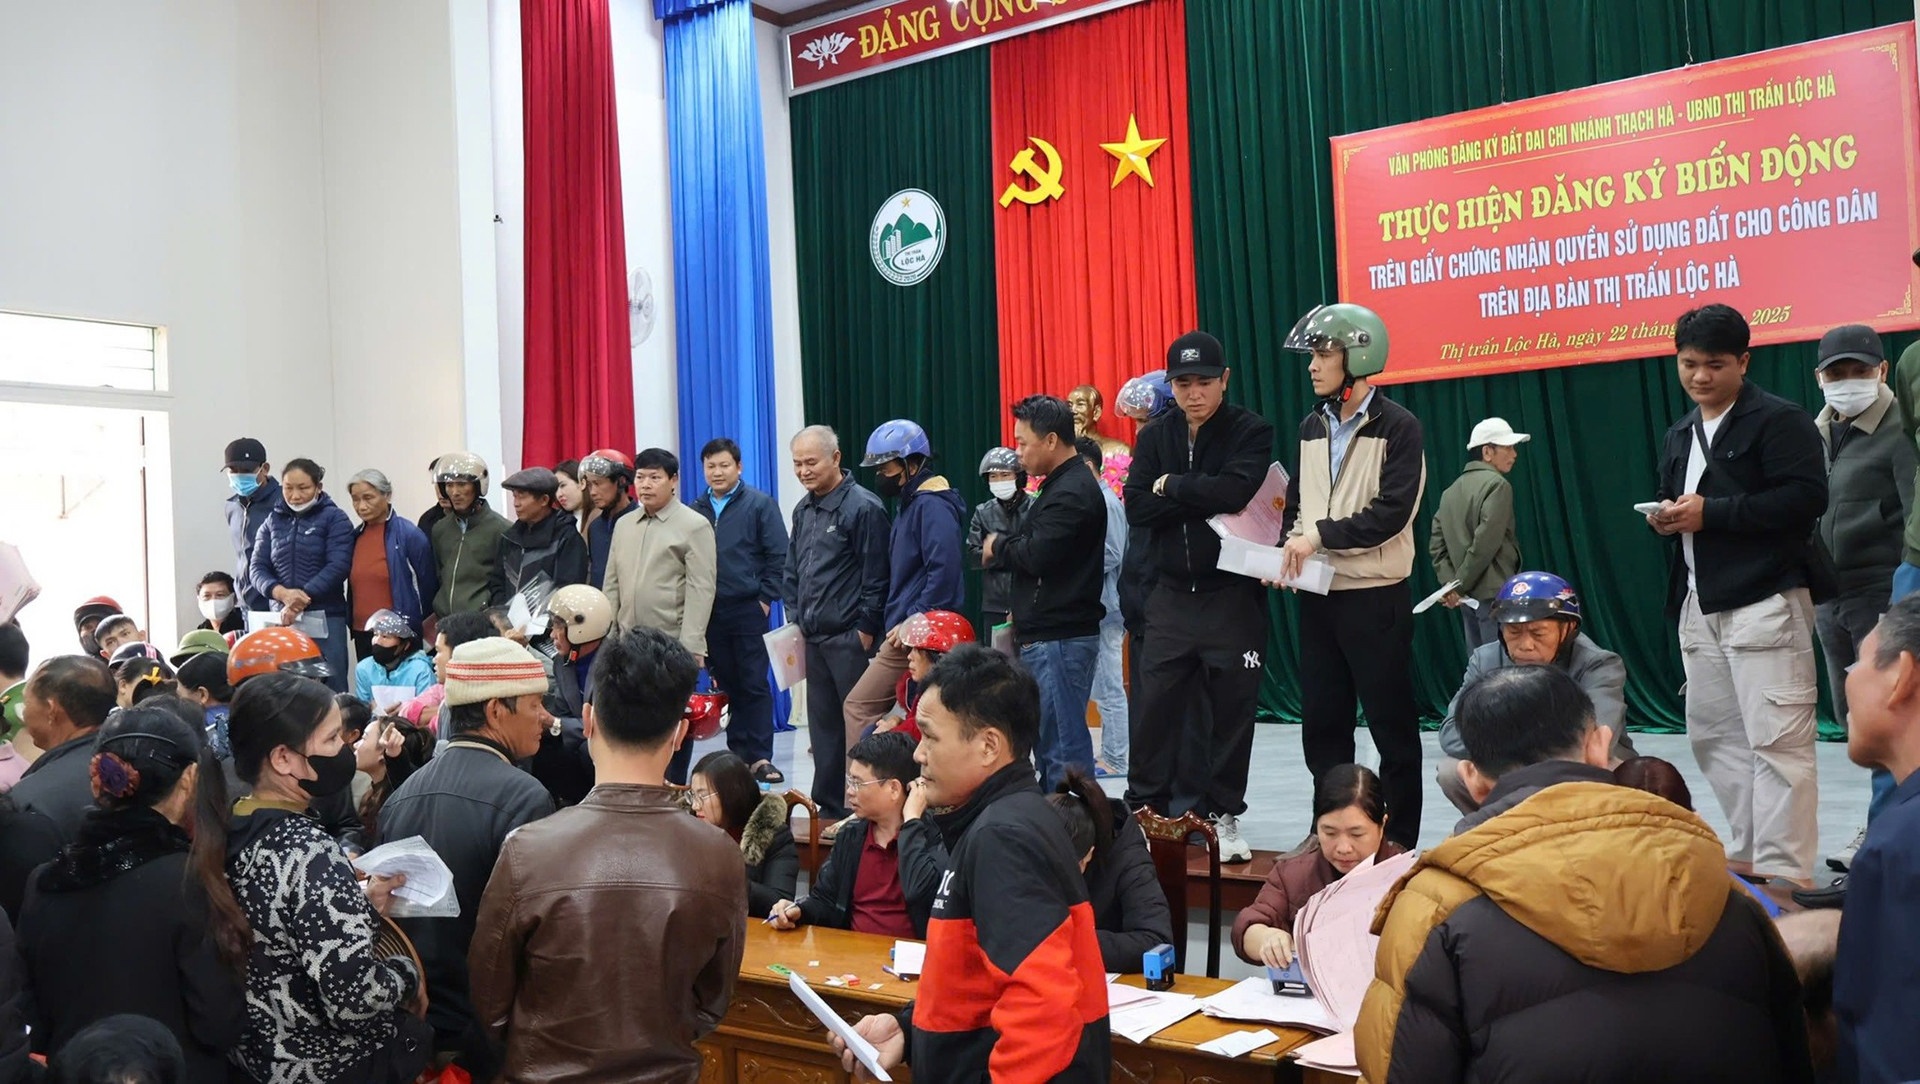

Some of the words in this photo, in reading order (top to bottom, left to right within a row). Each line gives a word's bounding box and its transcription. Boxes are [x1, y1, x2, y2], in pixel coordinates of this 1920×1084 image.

[858, 7, 941, 58] ĐẢNG
[1388, 152, 1410, 176] VĂN
[1412, 143, 1449, 172] PHÒNG
[1451, 139, 1481, 165] ĐĂNG
[1484, 131, 1498, 158] KÝ
[1502, 126, 1522, 155] ĐẤT
[1525, 129, 1545, 151] ĐAI
[1548, 125, 1568, 147] CHI
[1570, 115, 1612, 144] NHÁNH
[1614, 108, 1654, 138] THẠCH
[1657, 101, 1675, 128] HÀ
[1686, 96, 1722, 122] UBND
[1724, 90, 1746, 118] THỊ
[1748, 77, 1784, 111] TRẤN
[1787, 75, 1813, 108] LỘC
[1816, 70, 1837, 99] HÀ
[1378, 199, 1450, 244] THỰC
[1456, 185, 1523, 234] HIỆN
[1530, 173, 1616, 219] ĐĂNG
[1622, 157, 1668, 204] KÝ
[1675, 140, 1751, 197] BIẾN
[1760, 133, 1858, 188] ĐỘNG
[1369, 258, 1406, 290] TRÊN
[1410, 247, 1443, 286] GIẤY
[1448, 246, 1501, 280] CHỨNG
[1505, 237, 1550, 273] NHẬN
[1555, 224, 1609, 267] QUYỀN
[1614, 218, 1638, 255] SỬ
[1642, 219, 1690, 256] DỤNG
[1695, 205, 1730, 243] ĐẤT
[1735, 207, 1772, 239] CHO
[1778, 197, 1831, 233] CÔNG
[1836, 188, 1878, 224] DÂN
[1479, 283, 1519, 319] TRÊN
[1523, 284, 1551, 318] ĐỊA
[1555, 275, 1591, 308] BÀN
[1594, 275, 1620, 309] THỊ
[1625, 260, 1671, 300] TRẤN
[1676, 258, 1710, 297] LỘC
[1714, 255, 1740, 291] HÀ
[1439, 343, 1464, 361] Thị
[1467, 337, 1499, 357] trấn
[1503, 336, 1532, 356] Lộc
[1536, 330, 1561, 351] Hà,
[1565, 329, 1604, 350] ngày
[1609, 326, 1628, 342] 22
[1632, 320, 1677, 339] tháng
[1749, 305, 1792, 327] 2025
